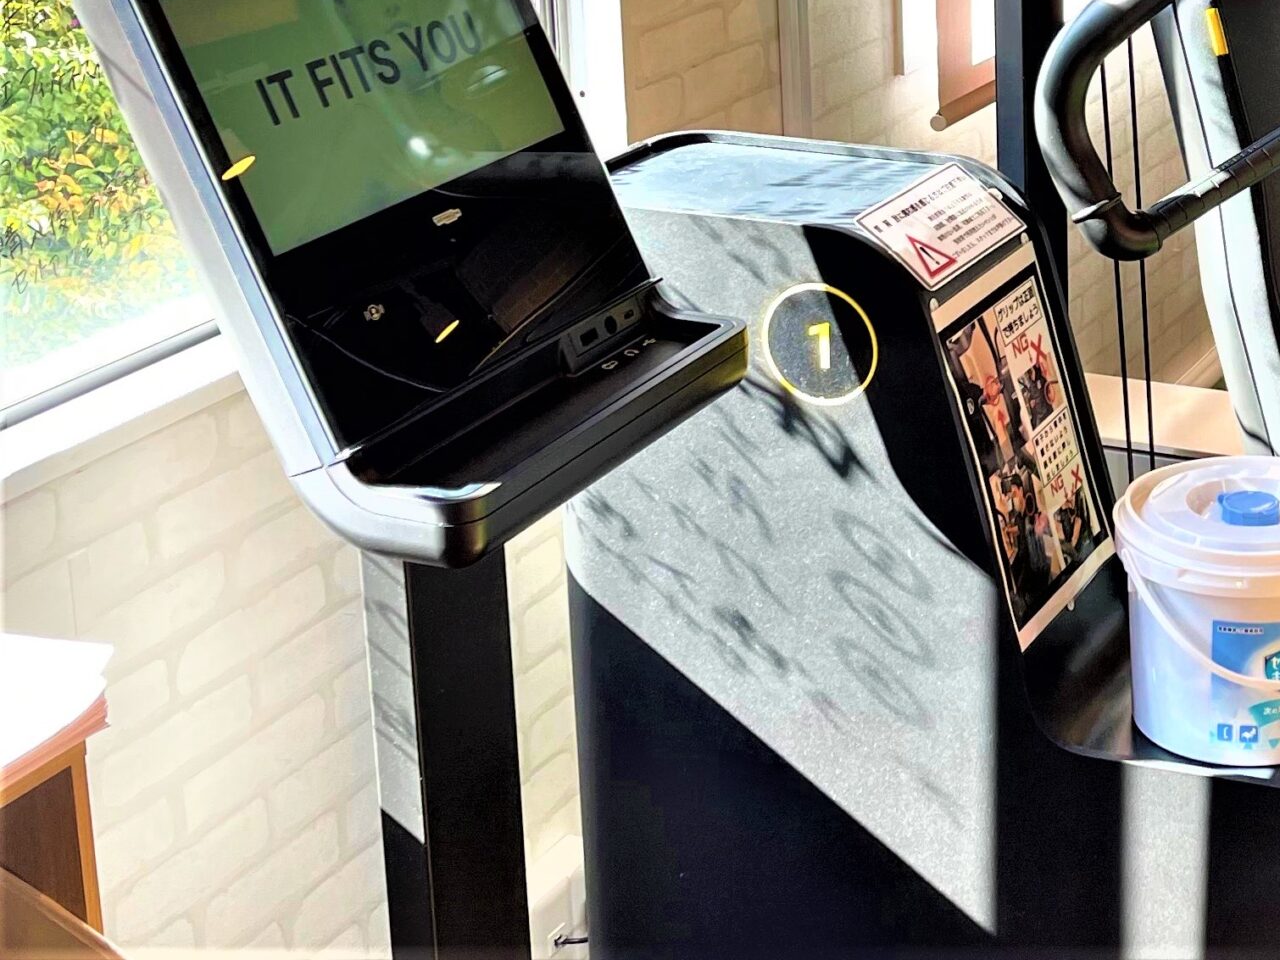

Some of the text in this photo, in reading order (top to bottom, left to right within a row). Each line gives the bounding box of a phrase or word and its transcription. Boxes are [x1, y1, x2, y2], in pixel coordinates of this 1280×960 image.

[255, 9, 481, 126] IT FITS YOU
[808, 321, 831, 369] 1
[1012, 332, 1029, 359] NG
[1050, 474, 1065, 497] NG
